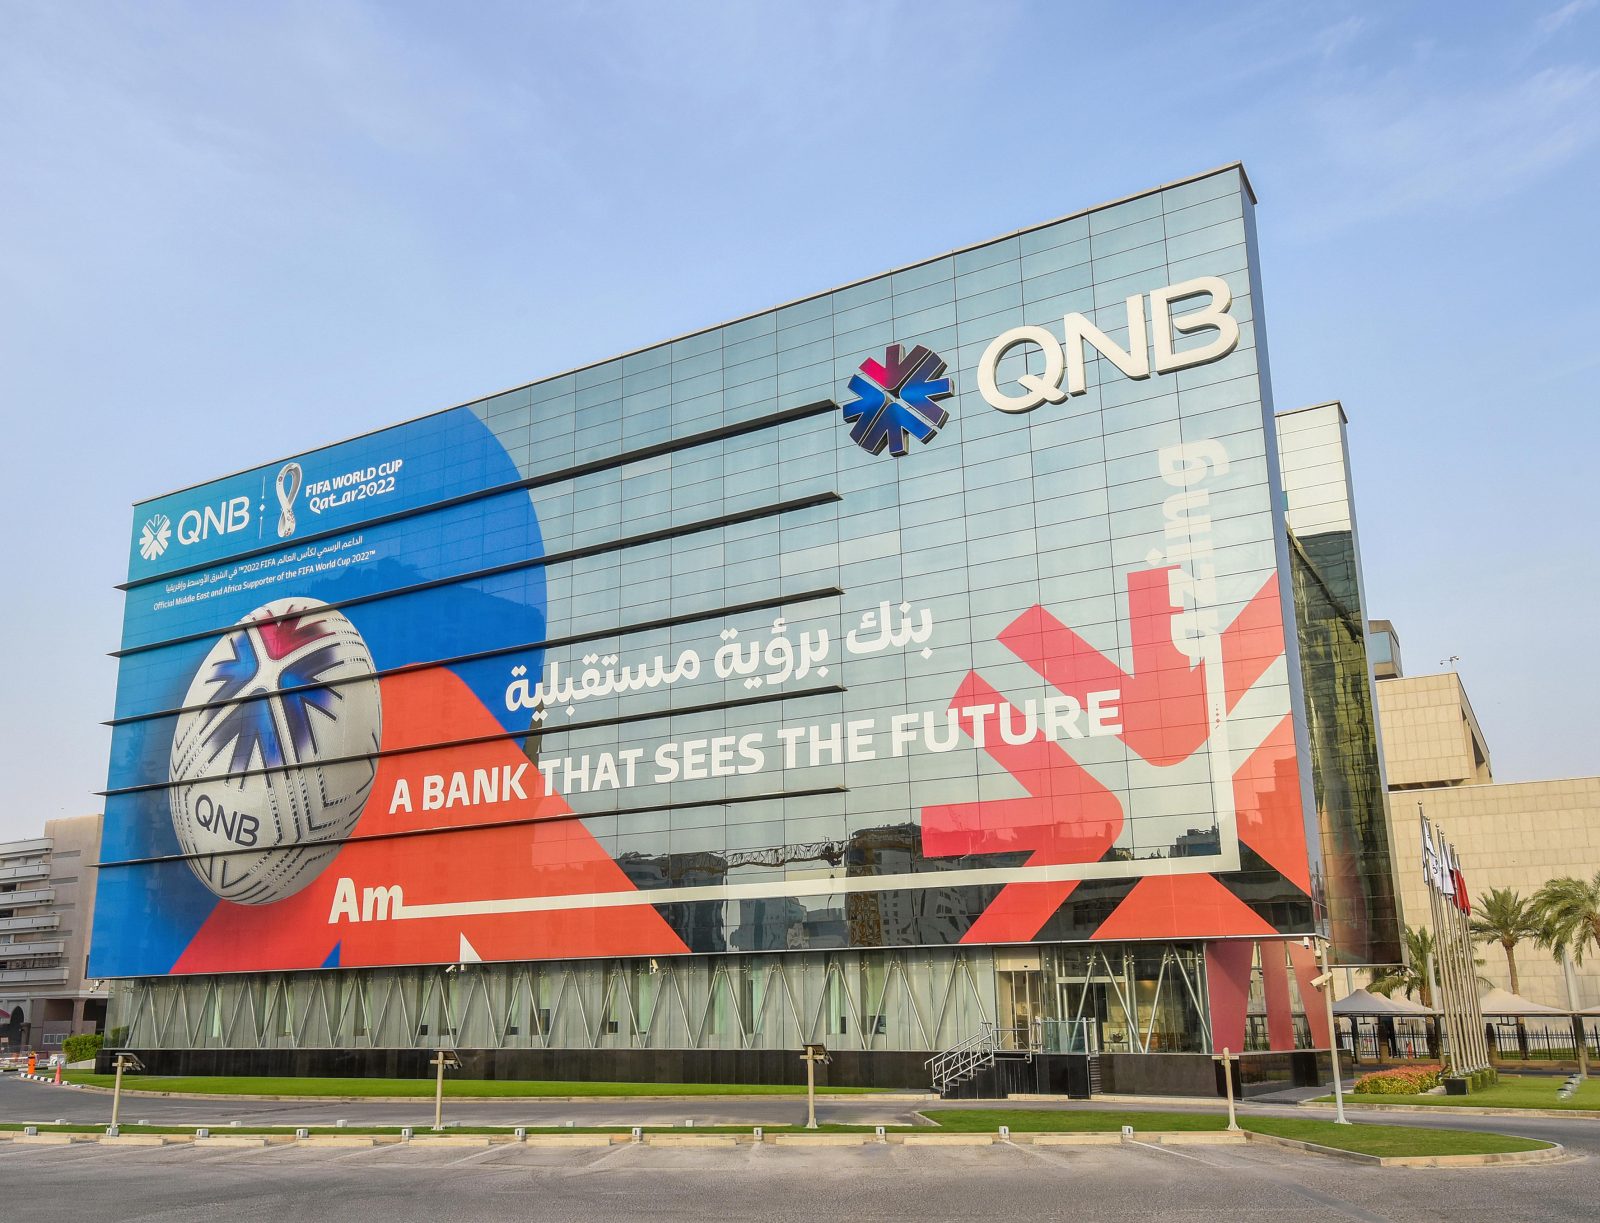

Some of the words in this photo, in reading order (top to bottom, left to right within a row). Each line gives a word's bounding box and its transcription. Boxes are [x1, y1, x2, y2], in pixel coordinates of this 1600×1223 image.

[976, 276, 1240, 414] QNB
[305, 477, 330, 498] FIFA
[332, 466, 376, 491] WORLD
[378, 459, 403, 476] CUP
[177, 496, 250, 545] QNB
[341, 535, 363, 549] الداعم
[260, 558, 276, 568] FIFA
[277, 552, 297, 566] العالم
[317, 541, 341, 558] الرسمي
[153, 597, 175, 611] Official
[175, 594, 196, 606] Middle
[196, 591, 210, 601] East
[210, 588, 223, 597] and
[223, 584, 242, 595] Africa
[242, 575, 276, 589] Supporter
[277, 572, 285, 581] of
[285, 569, 297, 579] the
[298, 566, 315, 576] FIFA
[315, 560, 336, 571] World
[336, 557, 351, 567] Cup
[209, 569, 228, 584] الشرق
[228, 568, 238, 581] في
[713, 616, 829, 690] برؤية
[845, 600, 934, 660] بنك
[505, 648, 701, 722] مستقبلية
[388, 778, 413, 815] A
[422, 762, 529, 811] BANK
[538, 748, 644, 797] THAT
[654, 732, 765, 783] SEES
[777, 718, 876, 769] THE
[891, 689, 1123, 757] FUTURE
[195, 794, 260, 847] QNB
